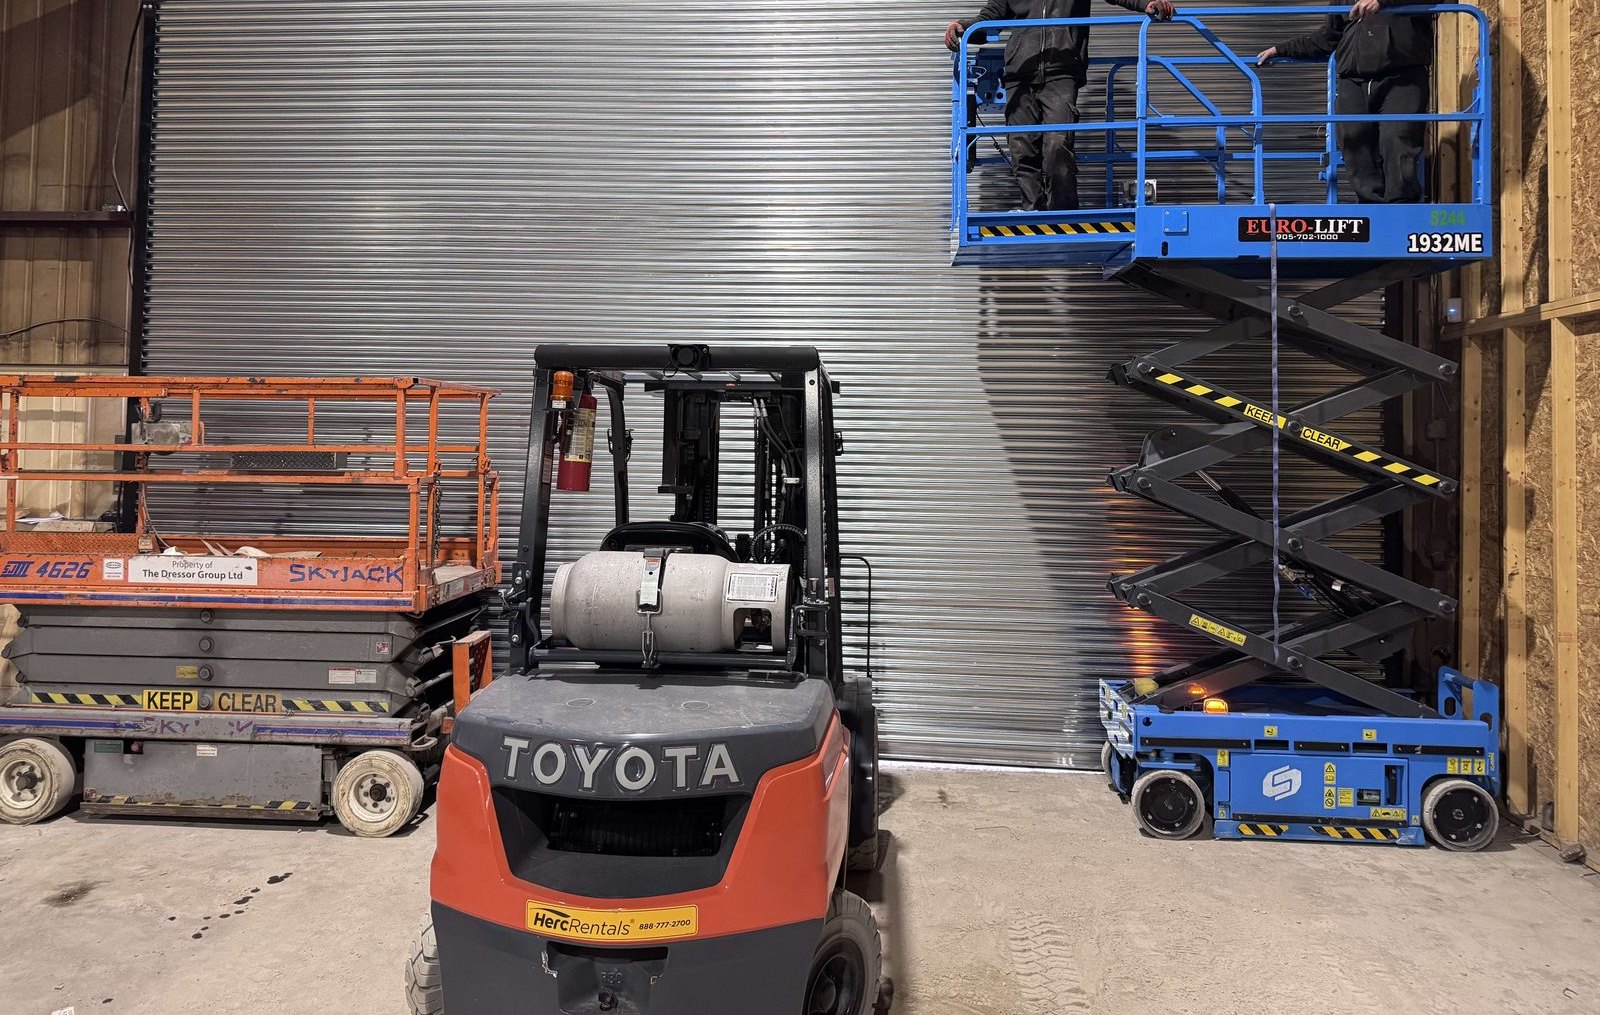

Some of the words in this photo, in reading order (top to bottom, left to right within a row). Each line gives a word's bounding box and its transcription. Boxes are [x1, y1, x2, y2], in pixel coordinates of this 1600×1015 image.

[1246, 219, 1364, 234] EURO-LIFT
[1408, 233, 1483, 253] 1932ME
[1302, 428, 1341, 450] CLEAR
[36, 561, 94, 578] 4626
[172, 560, 204, 569] Property
[205, 560, 213, 568] of
[289, 563, 404, 584] SKYJACK
[142, 569, 159, 578] The
[161, 570, 196, 579] Dressor
[197, 571, 226, 580] Group
[228, 571, 243, 580] Ltd
[147, 691, 193, 710] KEEP
[218, 692, 277, 712] CLEAR
[503, 736, 740, 791] TOYOTA
[639, 919, 691, 931] 888-777-2700
